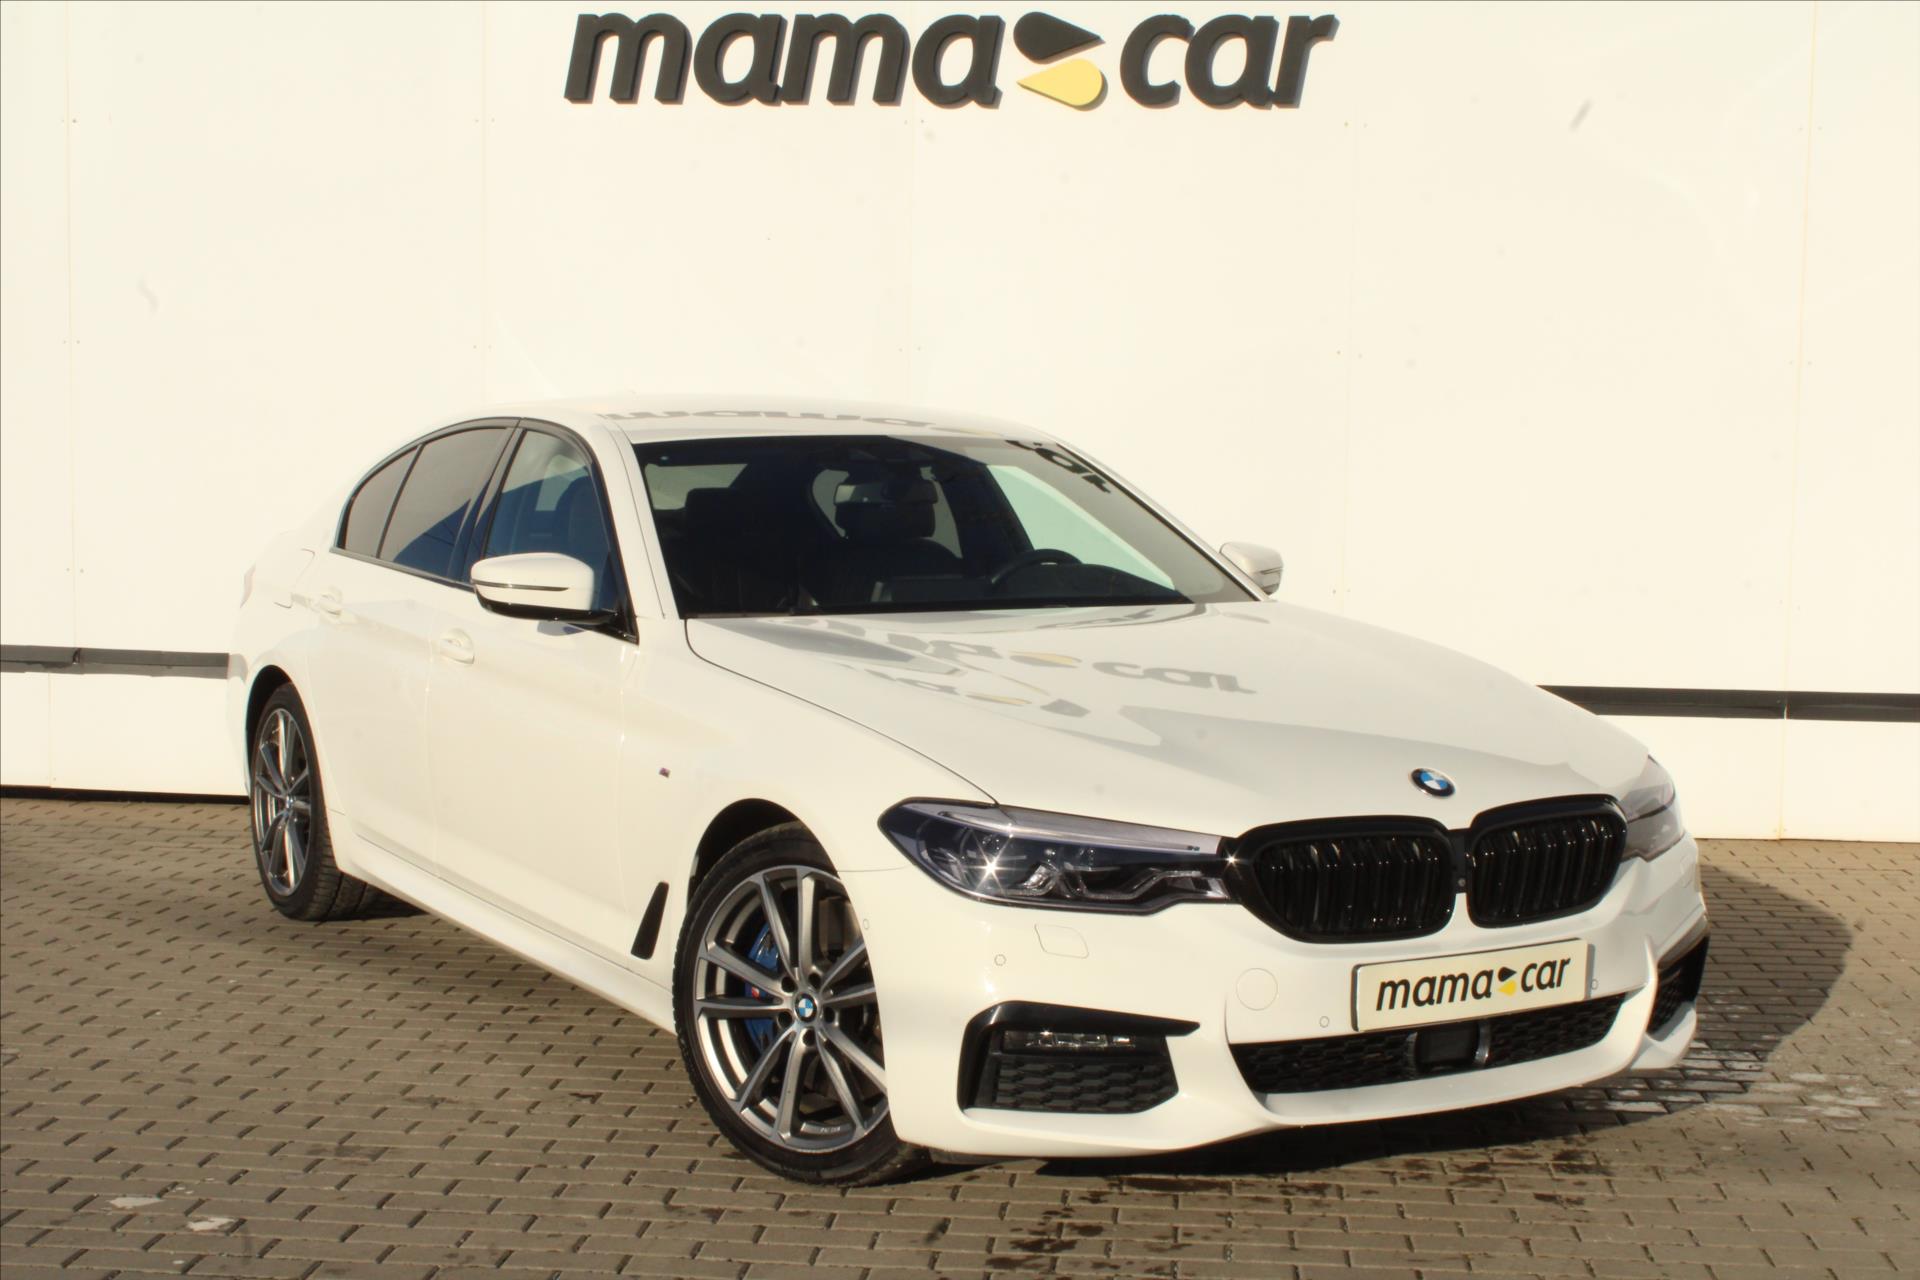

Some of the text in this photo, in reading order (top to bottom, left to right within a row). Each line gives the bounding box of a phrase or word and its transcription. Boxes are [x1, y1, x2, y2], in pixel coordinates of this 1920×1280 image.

[564, 12, 1340, 110] mama car
[1376, 958, 1571, 1011] mama car
